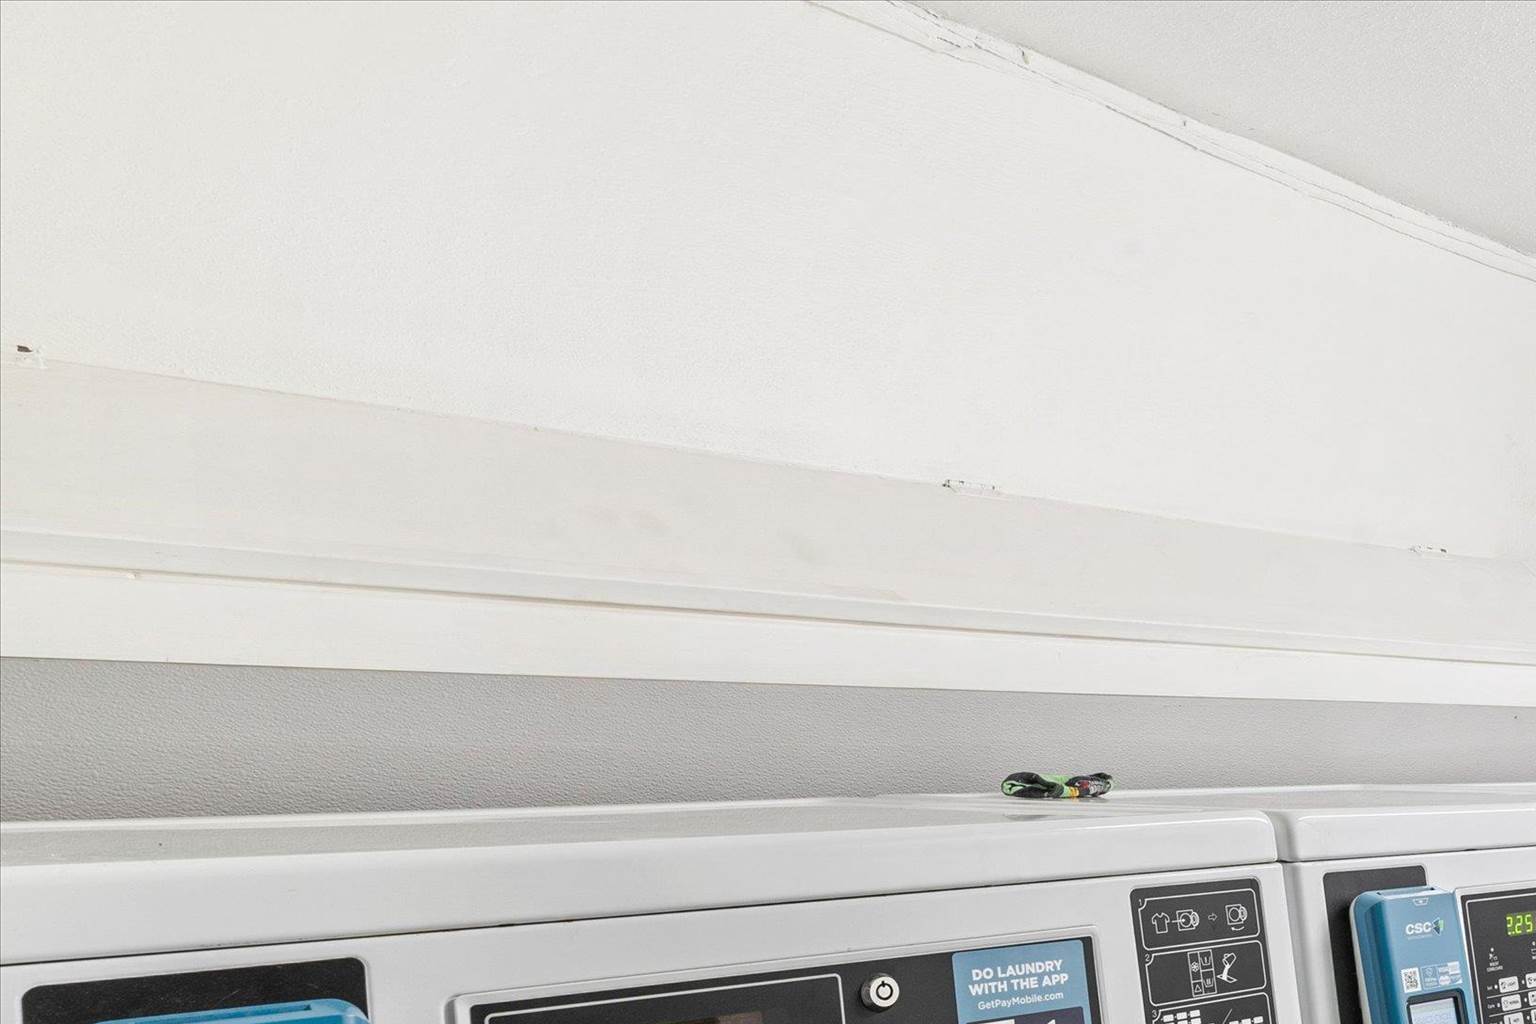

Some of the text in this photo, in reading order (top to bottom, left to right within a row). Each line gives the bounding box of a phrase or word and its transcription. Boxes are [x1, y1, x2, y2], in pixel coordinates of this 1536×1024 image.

[1406, 922, 1432, 935] CSC
[971, 959, 1062, 981] DO LAUNDRY
[968, 973, 1068, 996] WITH THE APP
[977, 990, 1063, 1011] GetPayMobile.com
